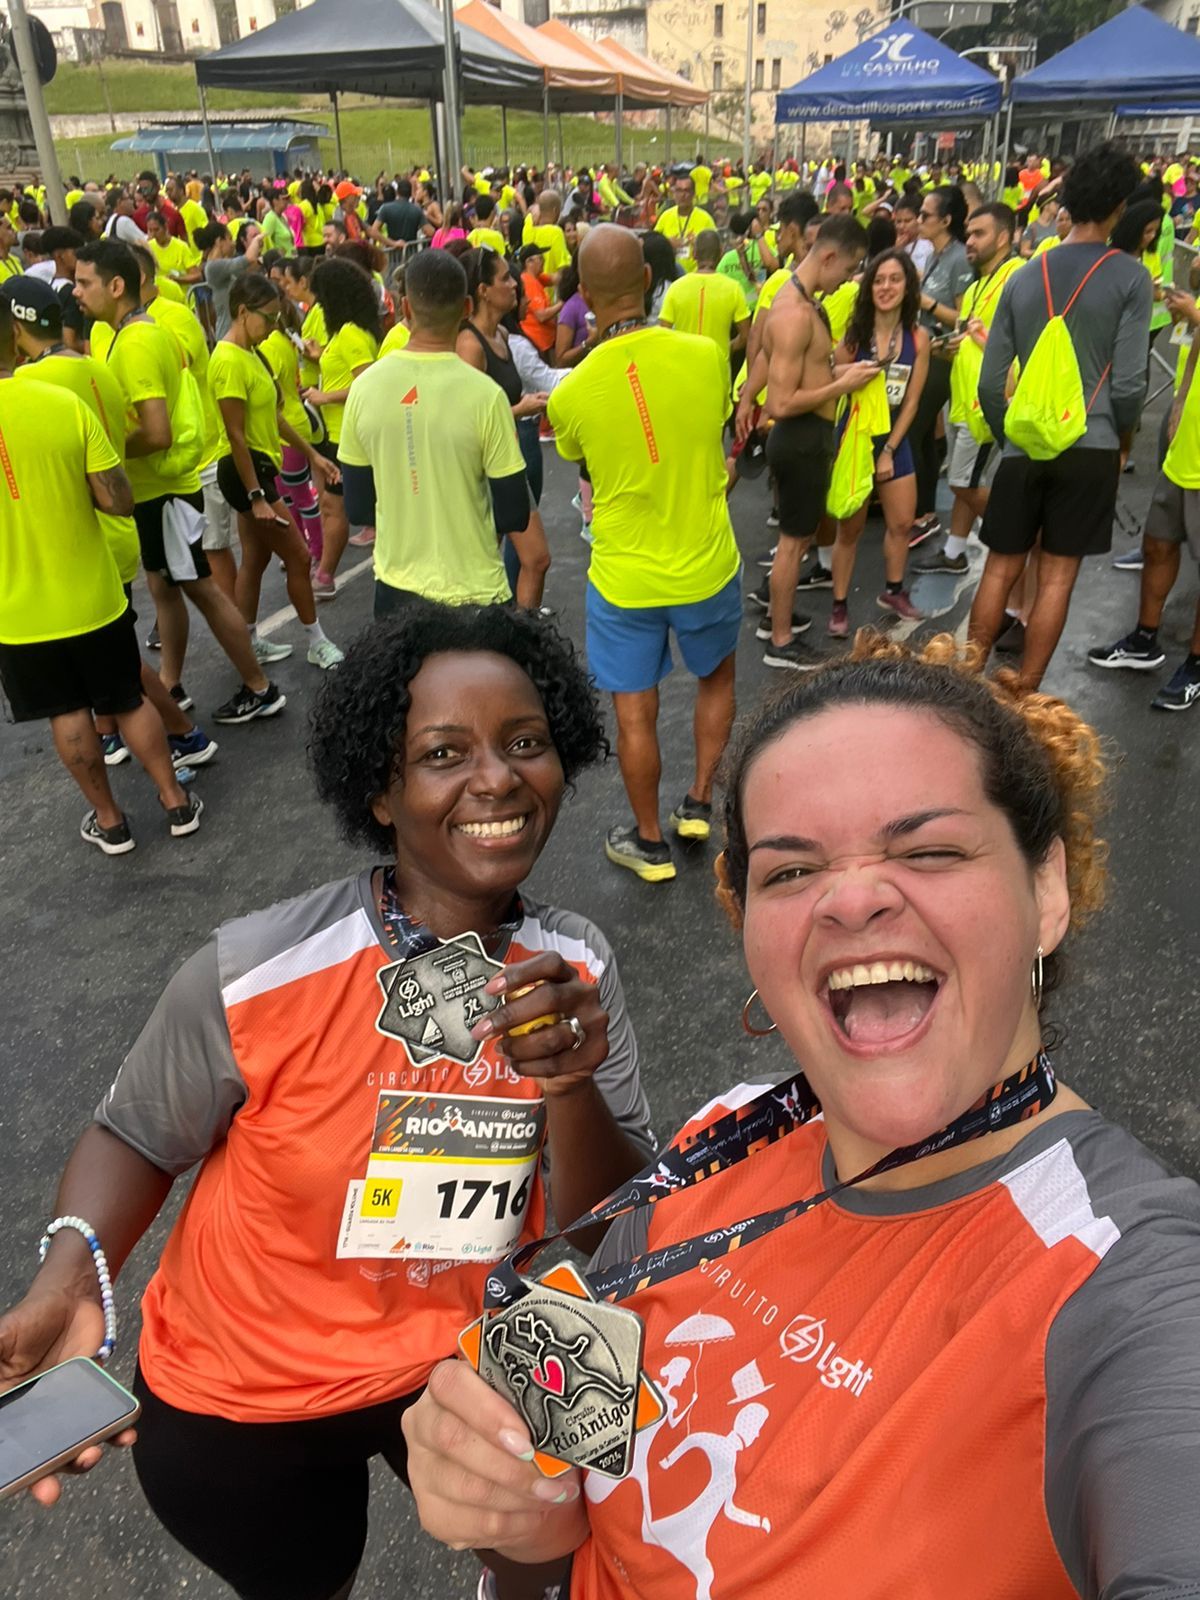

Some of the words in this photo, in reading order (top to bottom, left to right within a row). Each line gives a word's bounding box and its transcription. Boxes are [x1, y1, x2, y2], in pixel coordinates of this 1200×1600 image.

[863, 58, 940, 73] CASTILHO
[398, 993, 436, 1018] Light
[367, 1066, 450, 1087] CIRCUITO
[511, 1111, 527, 1120] Light
[405, 1116, 442, 1136] RIO
[463, 1119, 537, 1140] ANTIGO
[371, 1188, 393, 1206] 5K
[437, 1175, 531, 1220] 1716
[422, 1243, 435, 1251] Rio
[473, 1244, 493, 1255] Light
[432, 1261, 452, 1276] RIO
[565, 1404, 596, 1428] Circuito
[598, 1448, 623, 1470] 2024
